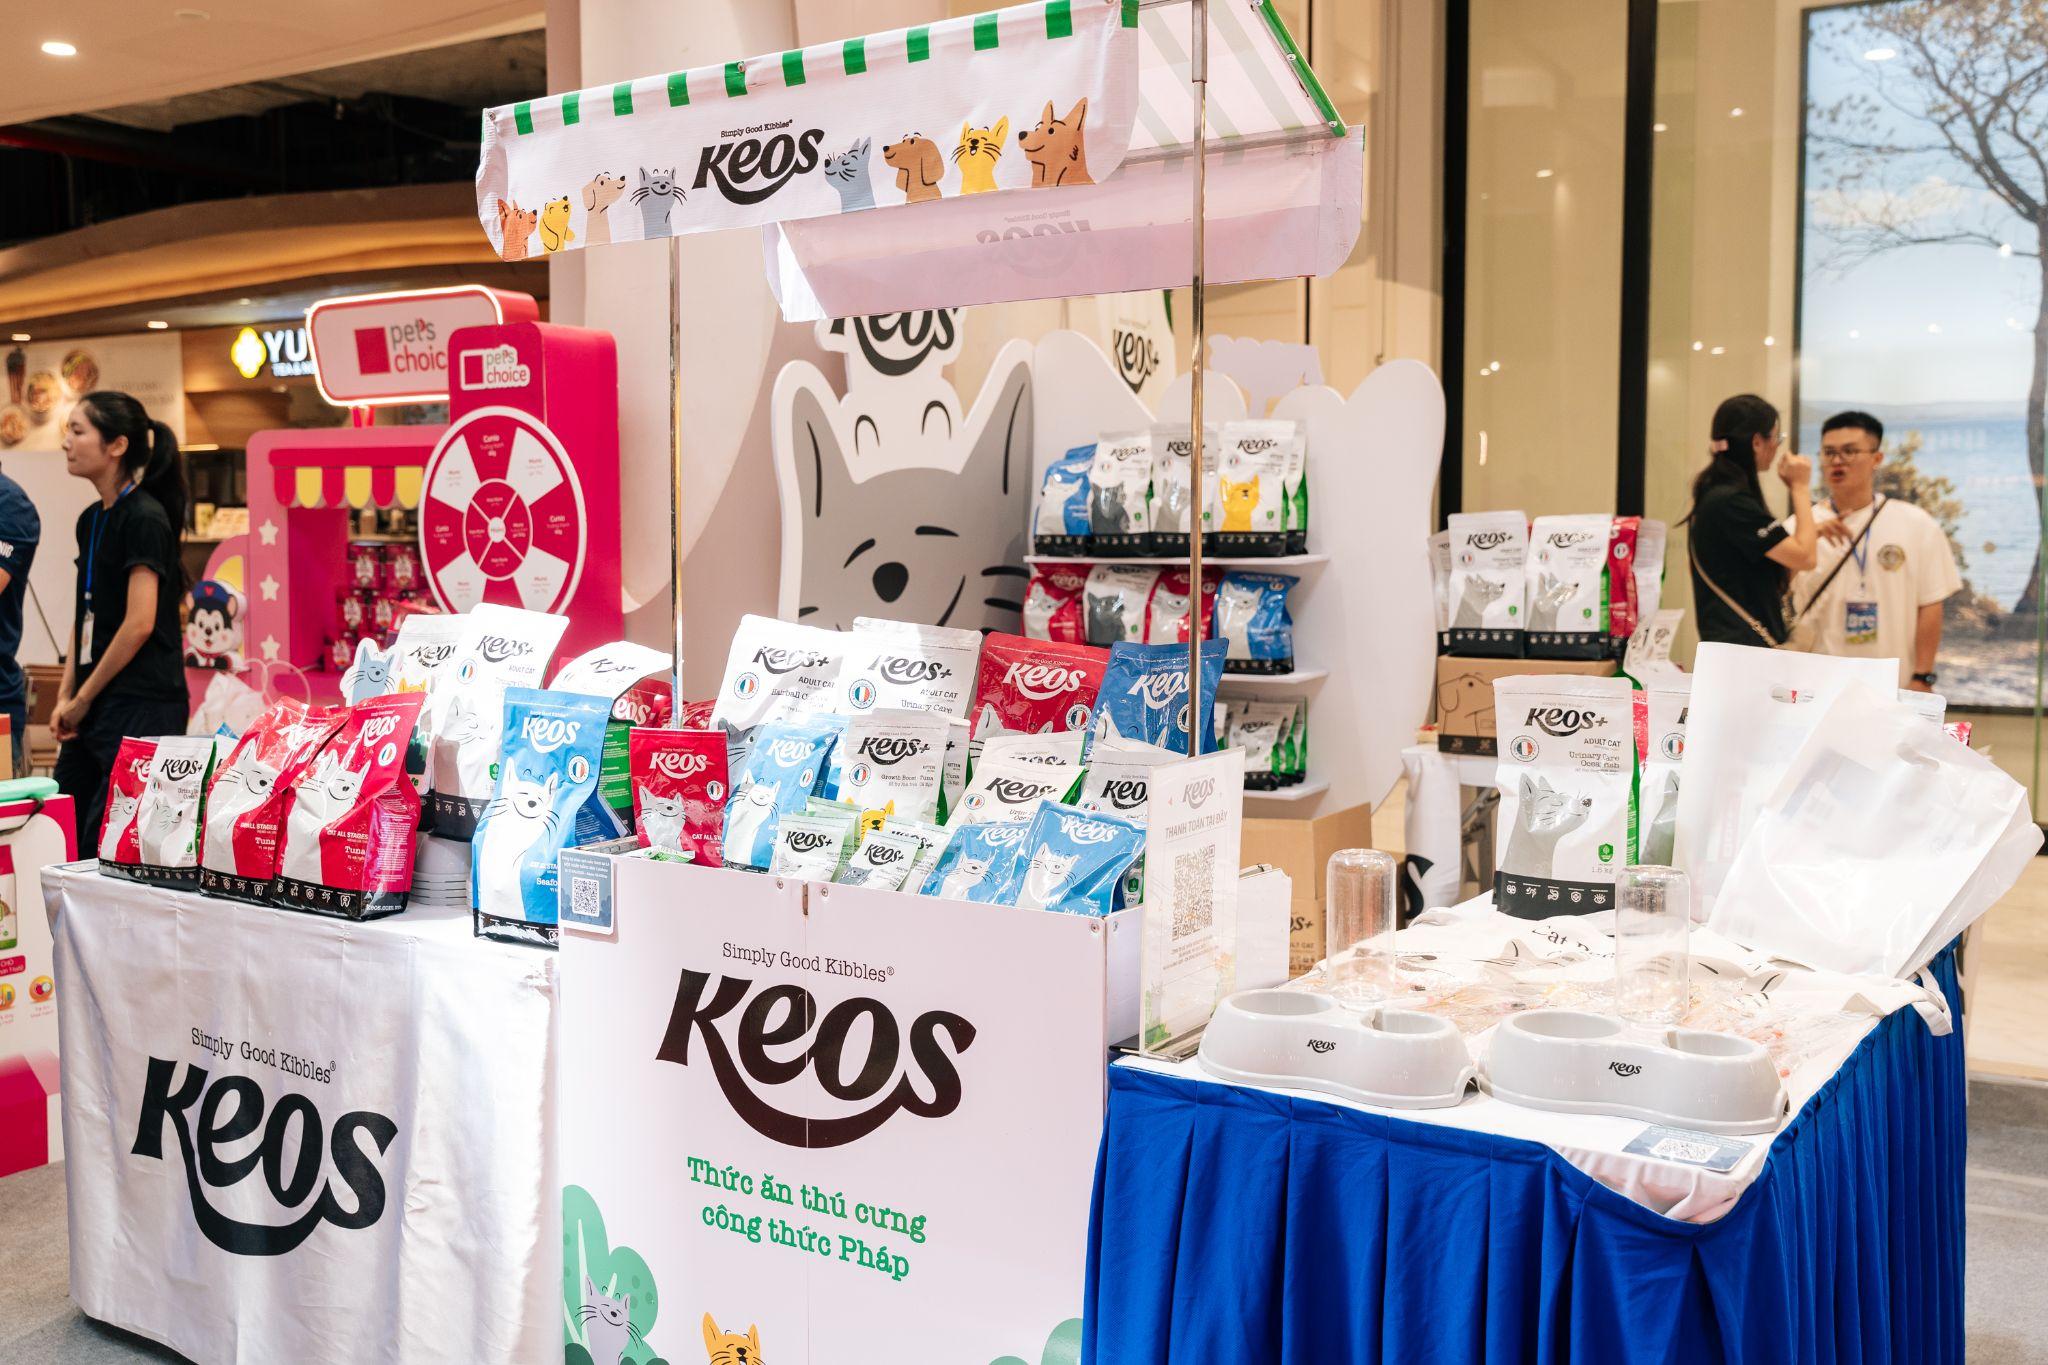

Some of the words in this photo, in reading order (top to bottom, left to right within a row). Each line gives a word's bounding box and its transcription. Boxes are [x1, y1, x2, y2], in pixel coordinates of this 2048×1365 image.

[720, 128, 745, 138] Simply
[745, 124, 764, 135] Good
[692, 128, 825, 206] Keos
[394, 346, 448, 373] choic
[486, 366, 527, 384] choice
[1466, 531, 1513, 550] Keos+
[798, 676, 821, 687] ADULT
[867, 655, 953, 685] Keos+
[1002, 662, 1087, 700] Keos
[943, 691, 959, 700] CAT
[357, 714, 400, 747] Keos
[521, 716, 581, 754] Keos
[1525, 707, 1608, 737] Keos+
[766, 739, 816, 768] Keos
[858, 737, 931, 766] Keos+
[1584, 738, 1606, 746] ADULT
[1607, 740, 1621, 748] CAT
[160, 758, 203, 781] Keos+
[649, 751, 708, 780] Keos
[1100, 780, 1148, 810] Keo
[1183, 777, 1216, 809] Keos
[255, 837, 276, 845] Tuna
[347, 832, 369, 840] STAGES
[786, 831, 832, 852] Keos+
[1165, 822, 1187, 839] THANH
[345, 845, 366, 854] Tuna
[864, 843, 905, 865] Keos+
[723, 942, 776, 968] Simply
[780, 951, 821, 972] Good
[191, 1027, 234, 1060] Simply
[240, 1041, 277, 1068] Good
[655, 967, 977, 1149] Keos
[1307, 1039, 1336, 1053] Keos
[1609, 1061, 1642, 1077] Keos
[131, 1055, 399, 1256] Keos
[687, 1156, 753, 1195] Thức
[760, 1172, 794, 1206] ăn
[800, 1183, 848, 1219] thú
[855, 1202, 927, 1244] cưng
[702, 1203, 763, 1243] công
[768, 1217, 832, 1257] thức
[838, 1234, 910, 1282] Pháp
